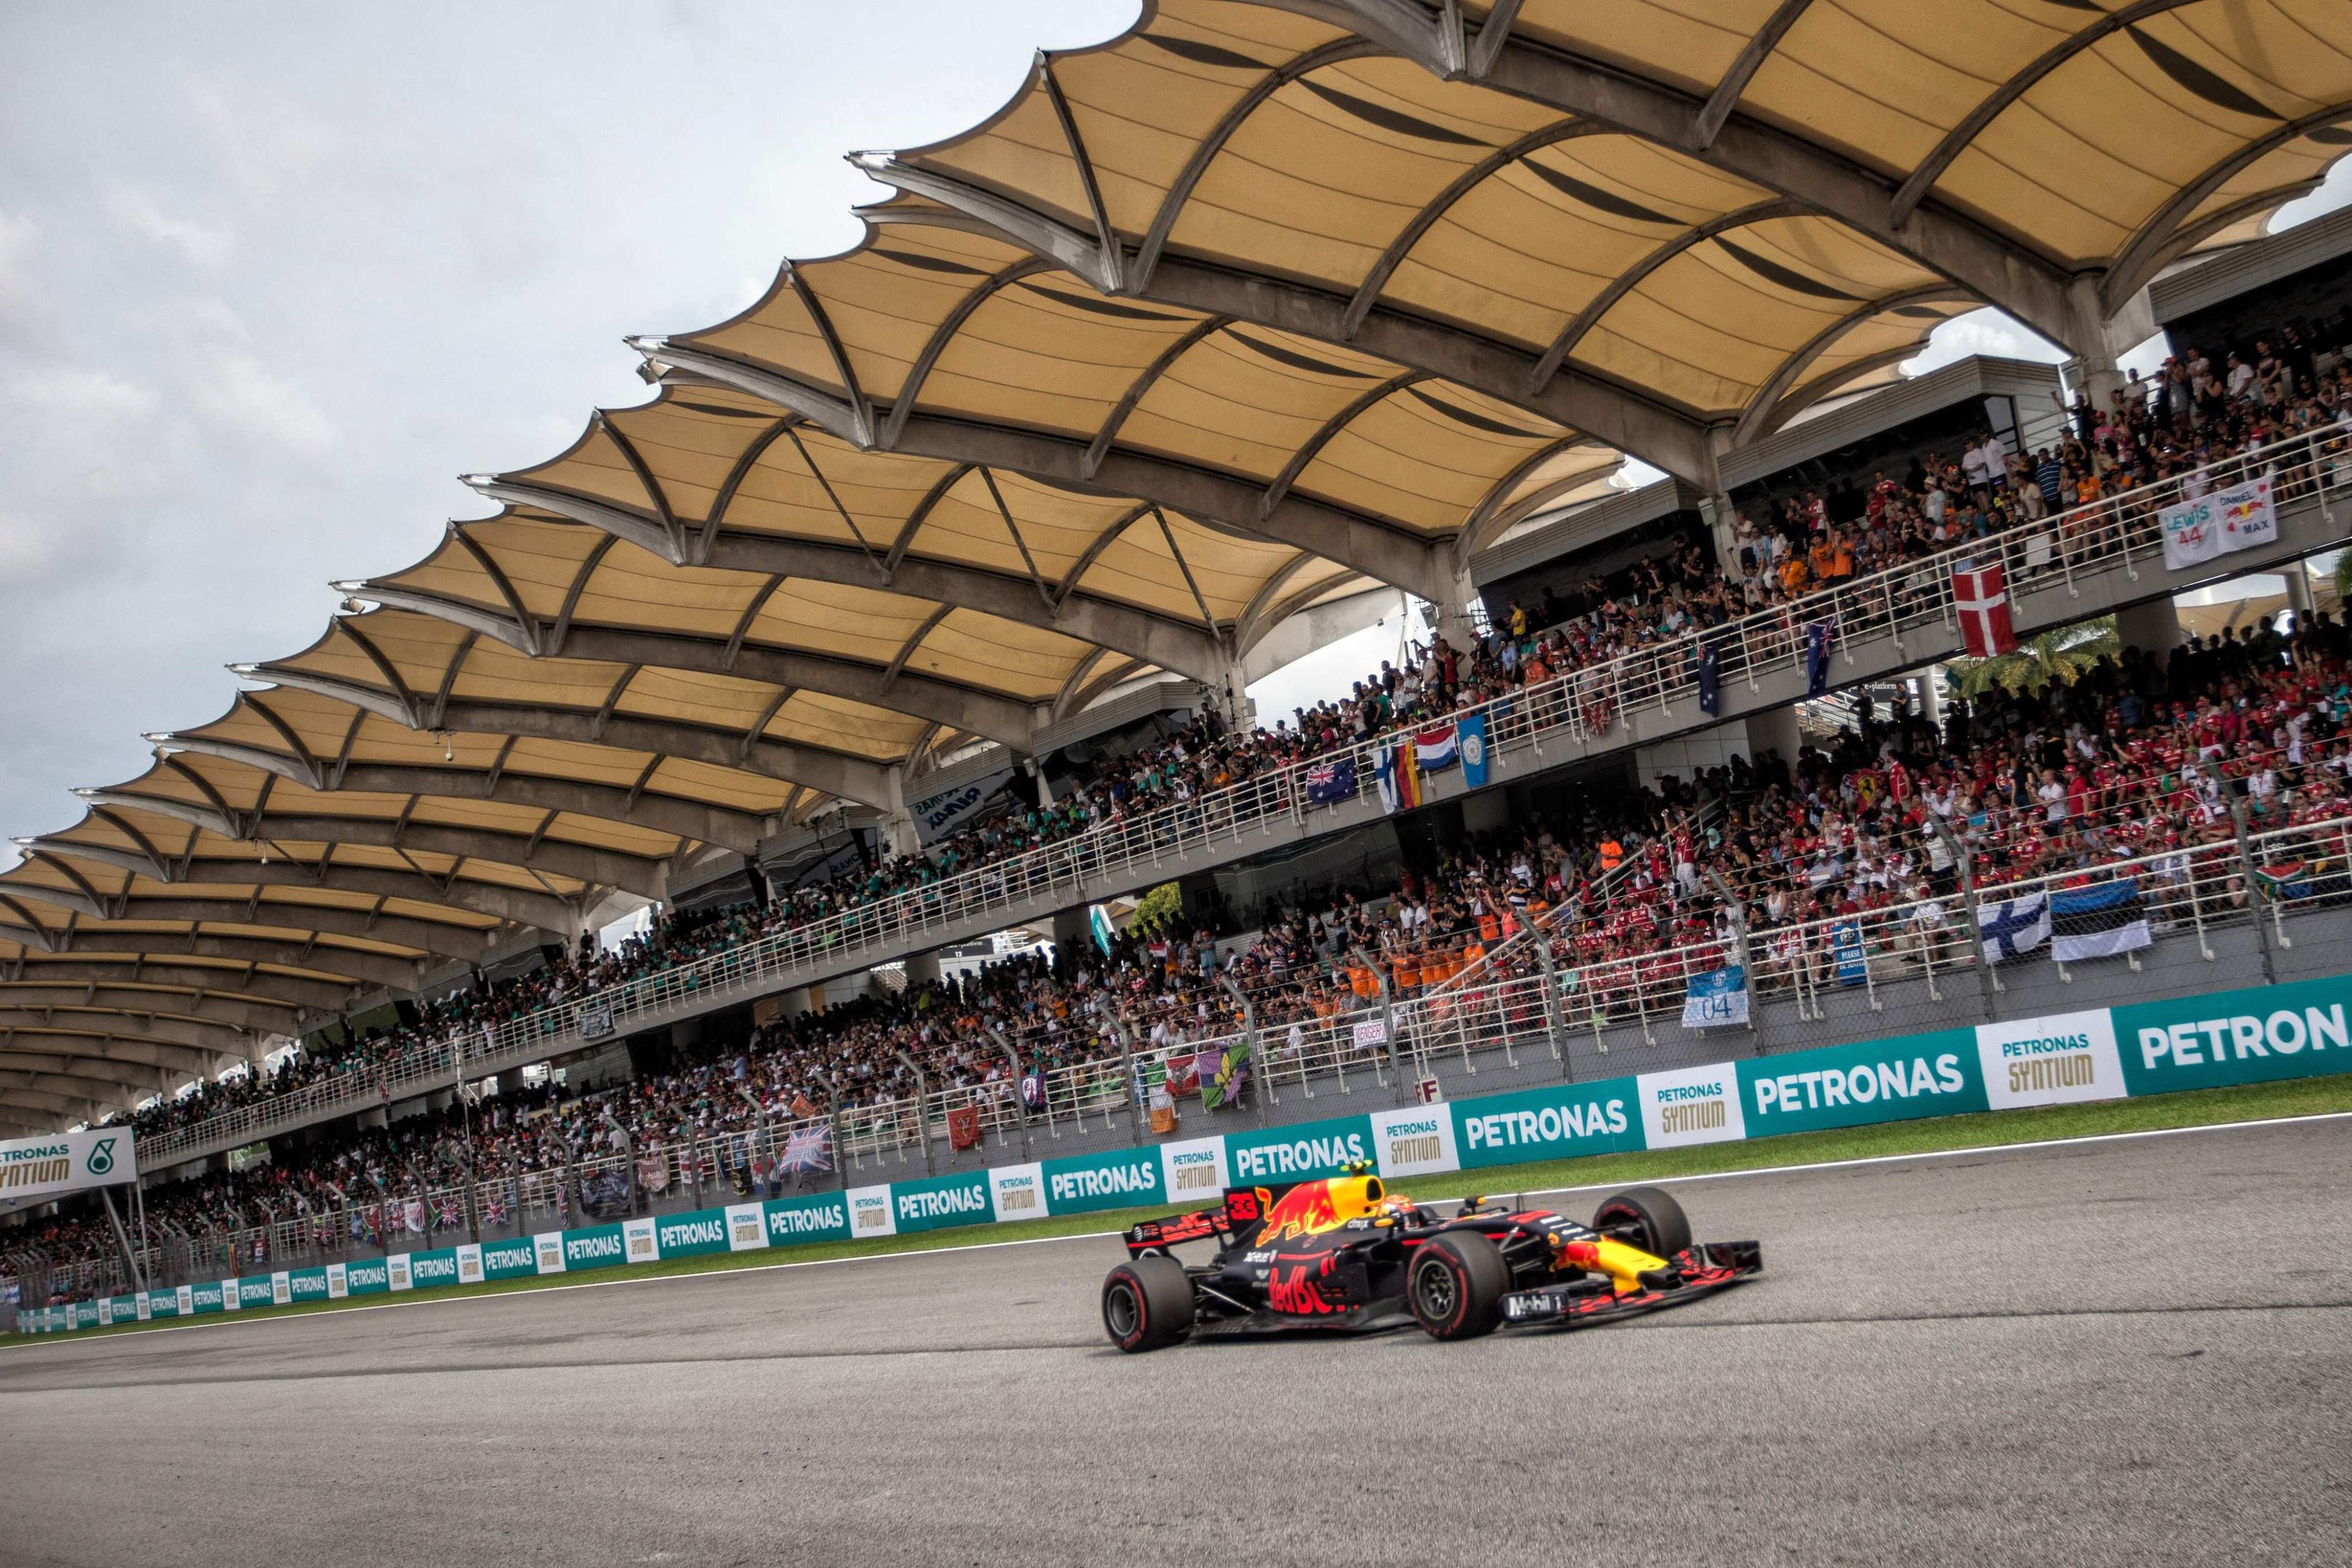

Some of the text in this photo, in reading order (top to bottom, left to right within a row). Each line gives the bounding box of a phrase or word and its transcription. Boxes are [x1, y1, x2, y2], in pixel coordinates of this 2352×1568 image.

[2220, 491, 2255, 506] DANIEL
[2179, 526, 2203, 546] 44
[2243, 519, 2269, 534] MAX
[1841, 950, 1861, 960] PLEASE
[1702, 996, 1732, 1021] 04
[2002, 1034, 2089, 1057] PETRONAS
[2138, 1003, 2352, 1069] PETRON
[1755, 1053, 1964, 1115] PETRONAS
[2008, 1054, 2094, 1093] SYNTIUM
[1421, 1079, 1437, 1103] F
[1657, 1082, 1723, 1103] PETRONAS
[1387, 1120, 1438, 1138] PETRONAS
[1465, 1099, 1628, 1150] PETRONAS
[1662, 1101, 1726, 1134] SYNTIUM
[0, 1144, 70, 1162] TRONAS
[1173, 1151, 1214, 1165] PETRONAS
[1236, 1133, 1364, 1177] PETRONAS
[1391, 1136, 1441, 1164] SYNTIUM
[999, 1177, 1033, 1189] PETRONAS
[1050, 1161, 1156, 1201] PETRONAS
[1176, 1165, 1216, 1191] SYNTIUM
[855, 1197, 883, 1207] PETRONAS
[899, 1185, 985, 1220] PETRONAS
[1002, 1189, 1036, 1211] SYNTIUM
[1228, 1193, 1258, 1220] 33
[733, 1214, 757, 1223] PETRONAS
[769, 1205, 844, 1235] PETRONAS
[661, 1220, 724, 1248] PETRONAS
[485, 1246, 533, 1270] PETRONAS
[566, 1234, 621, 1260] PETRONAS
[348, 1267, 386, 1287] PETRONAS
[413, 1257, 455, 1278] PETRONAS
[240, 1283, 271, 1300] PETRONAS
[292, 1275, 326, 1294] PETRONAS
[1508, 1294, 1551, 1316] Mobil
